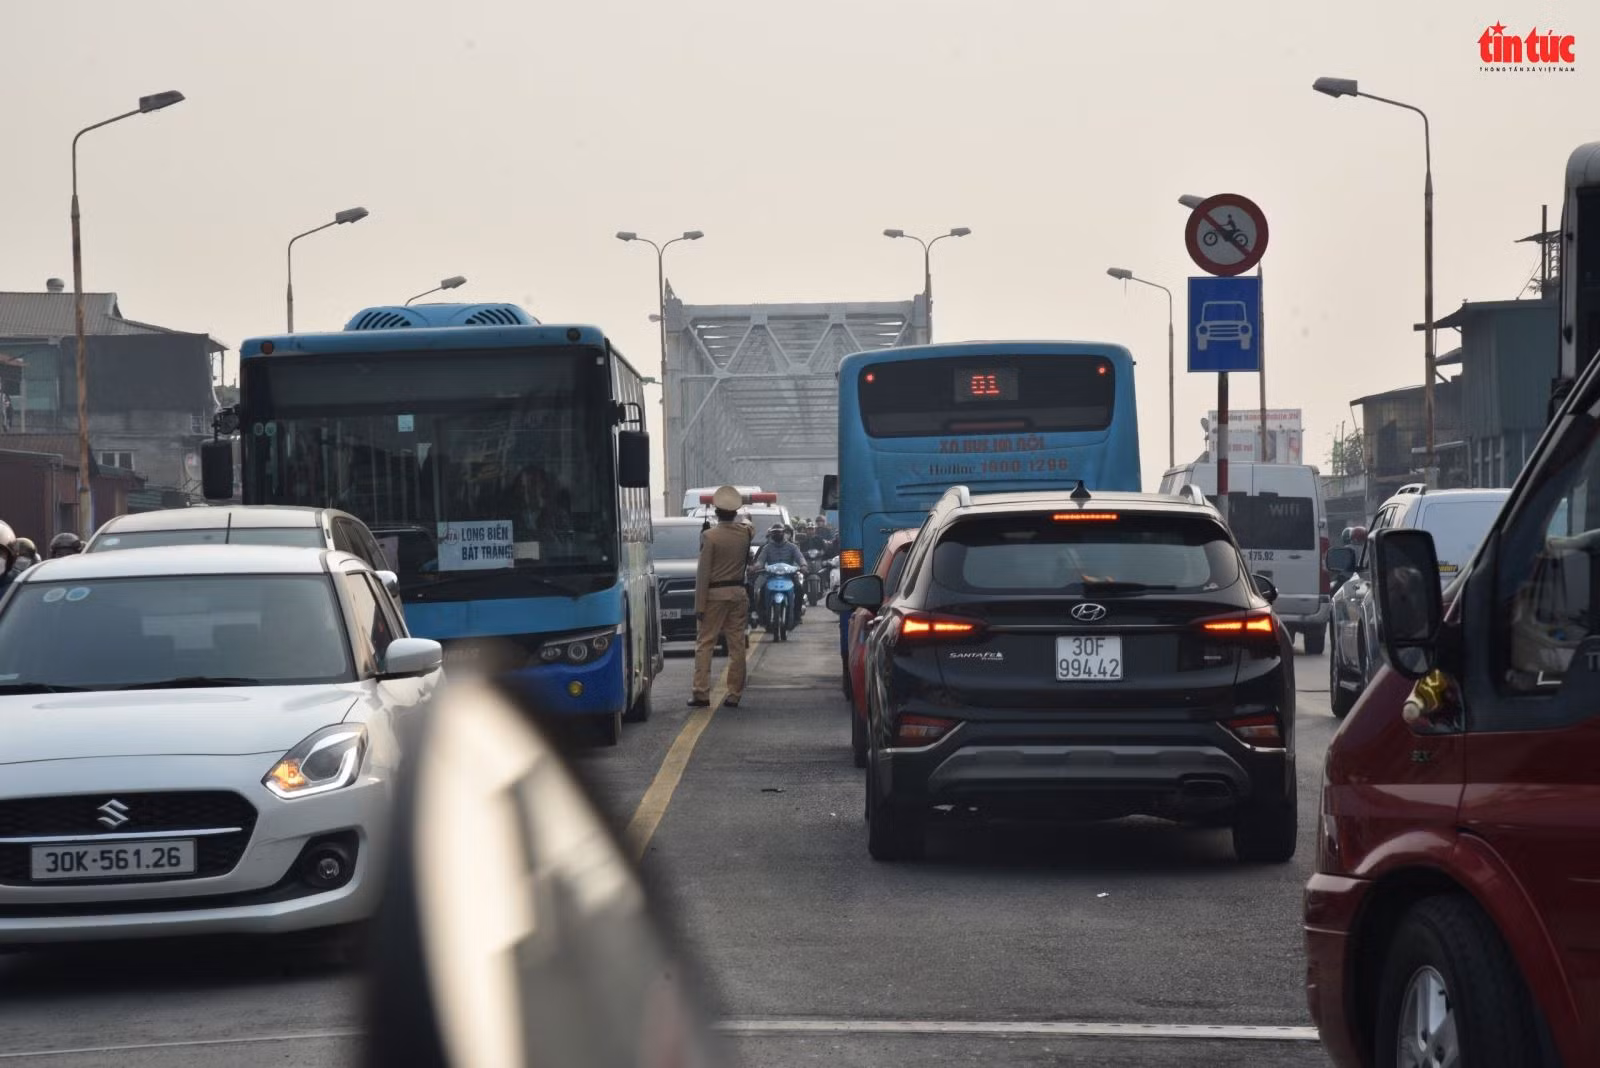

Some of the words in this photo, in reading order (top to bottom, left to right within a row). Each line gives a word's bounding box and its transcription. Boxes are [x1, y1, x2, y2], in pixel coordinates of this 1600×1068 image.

[971, 375, 1000, 394] 01
[461, 527, 485, 542] LONG
[487, 524, 508, 541] BIÊN
[1072, 637, 1106, 657] 30F
[1059, 658, 1120, 678] 994.42
[45, 847, 181, 873] 30K-561.26
